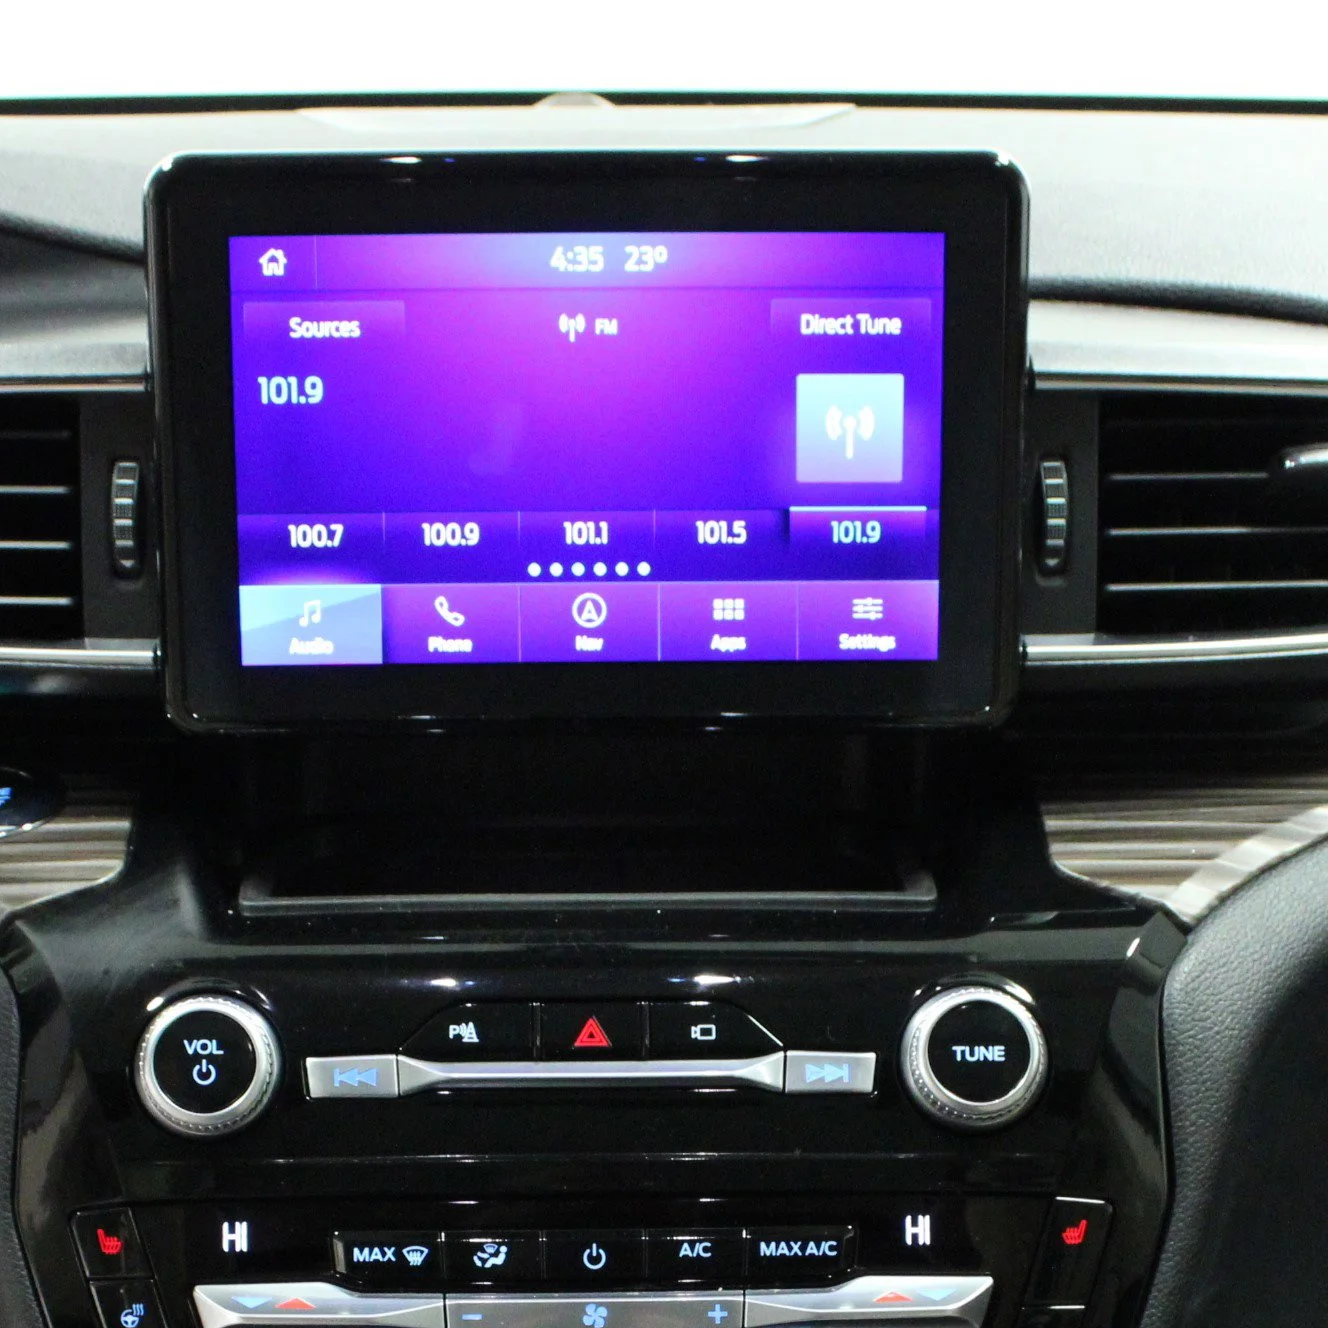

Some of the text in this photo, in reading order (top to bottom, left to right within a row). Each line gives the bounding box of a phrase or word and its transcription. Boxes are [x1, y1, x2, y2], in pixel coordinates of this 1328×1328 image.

[549, 245, 605, 274] 4:35
[288, 316, 361, 340] Sources
[594, 319, 618, 336] FM
[800, 313, 902, 337] Direct Tune
[256, 376, 324, 406] 101.9
[287, 523, 344, 549] 100.7
[421, 522, 480, 548] 100.9
[563, 521, 609, 547] 101.1
[695, 520, 747, 546] 101.5
[830, 519, 882, 545] 101.9
[427, 634, 473, 653] Phone
[575, 633, 604, 652] Nav
[710, 633, 746, 656] Apps
[838, 632, 897, 655] Settings
[183, 1038, 224, 1056] VOL
[951, 1044, 1007, 1063] TUNE
[222, 1221, 248, 1253] HI
[905, 1214, 931, 1246] HI
[353, 1246, 396, 1263] MAX
[679, 1241, 712, 1258] A/C
[759, 1240, 838, 1257] MAX A/C
